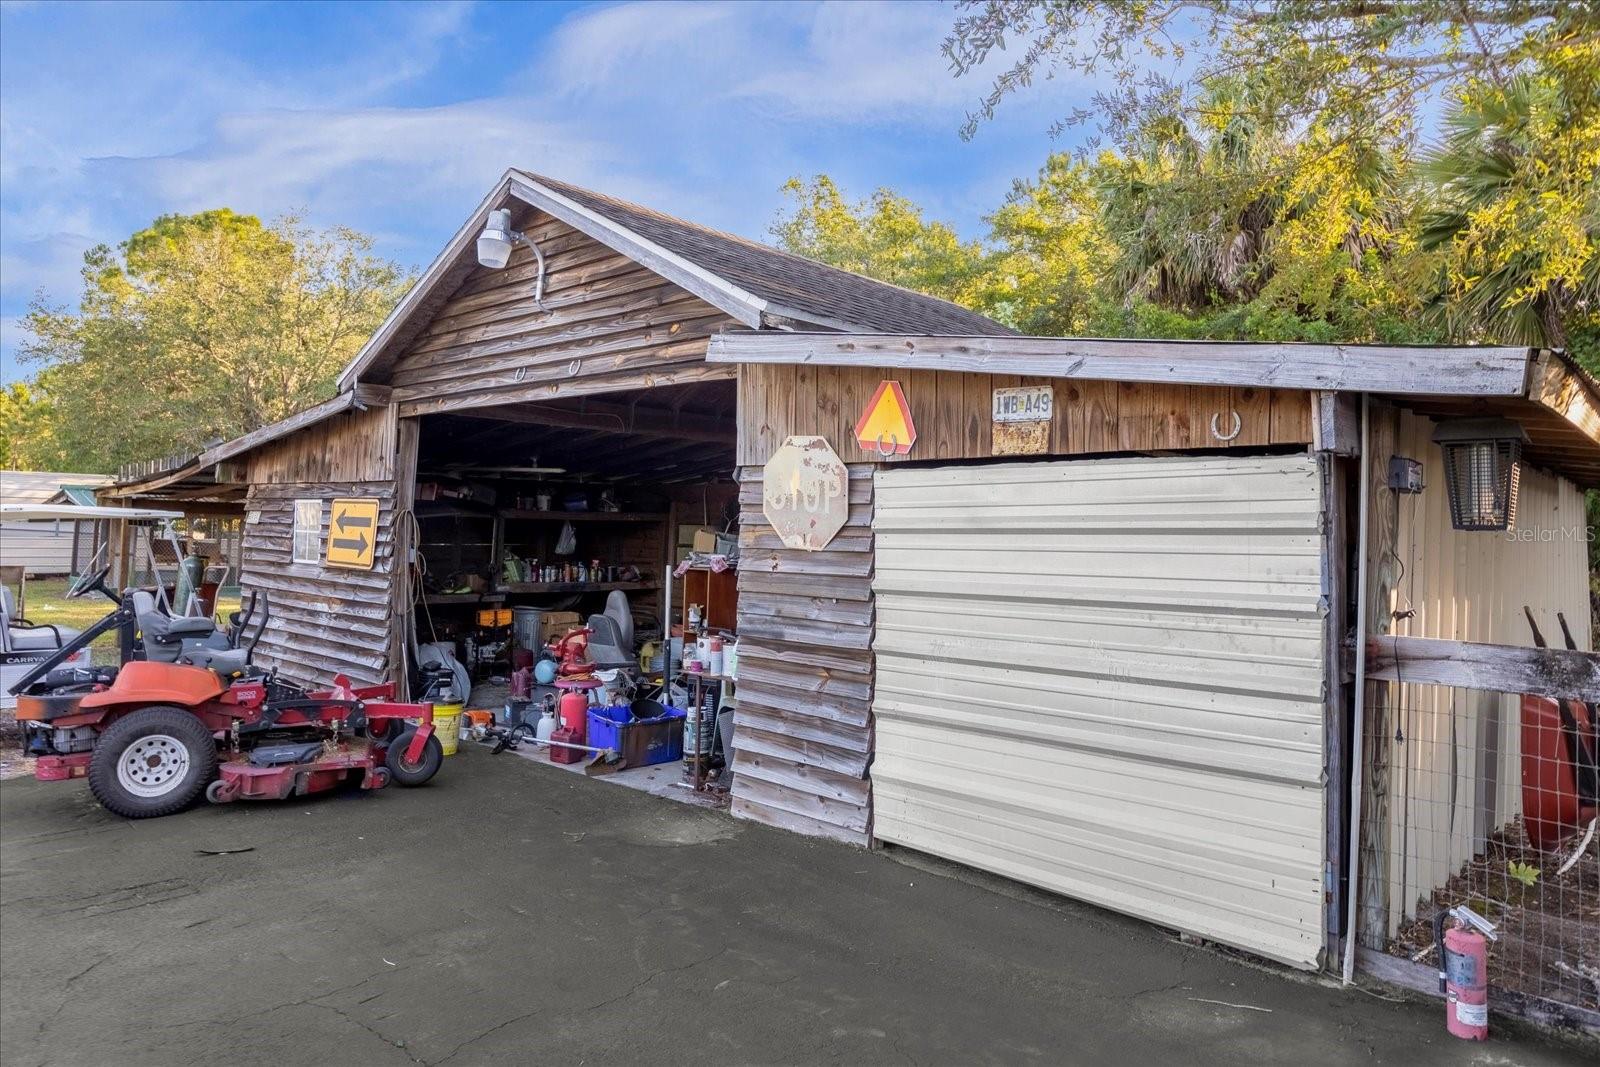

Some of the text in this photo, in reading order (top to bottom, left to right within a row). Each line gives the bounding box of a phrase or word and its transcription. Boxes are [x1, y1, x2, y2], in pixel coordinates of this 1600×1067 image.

[996, 392, 1050, 415] 1WB A49
[6, 656, 49, 664] CARRYA
